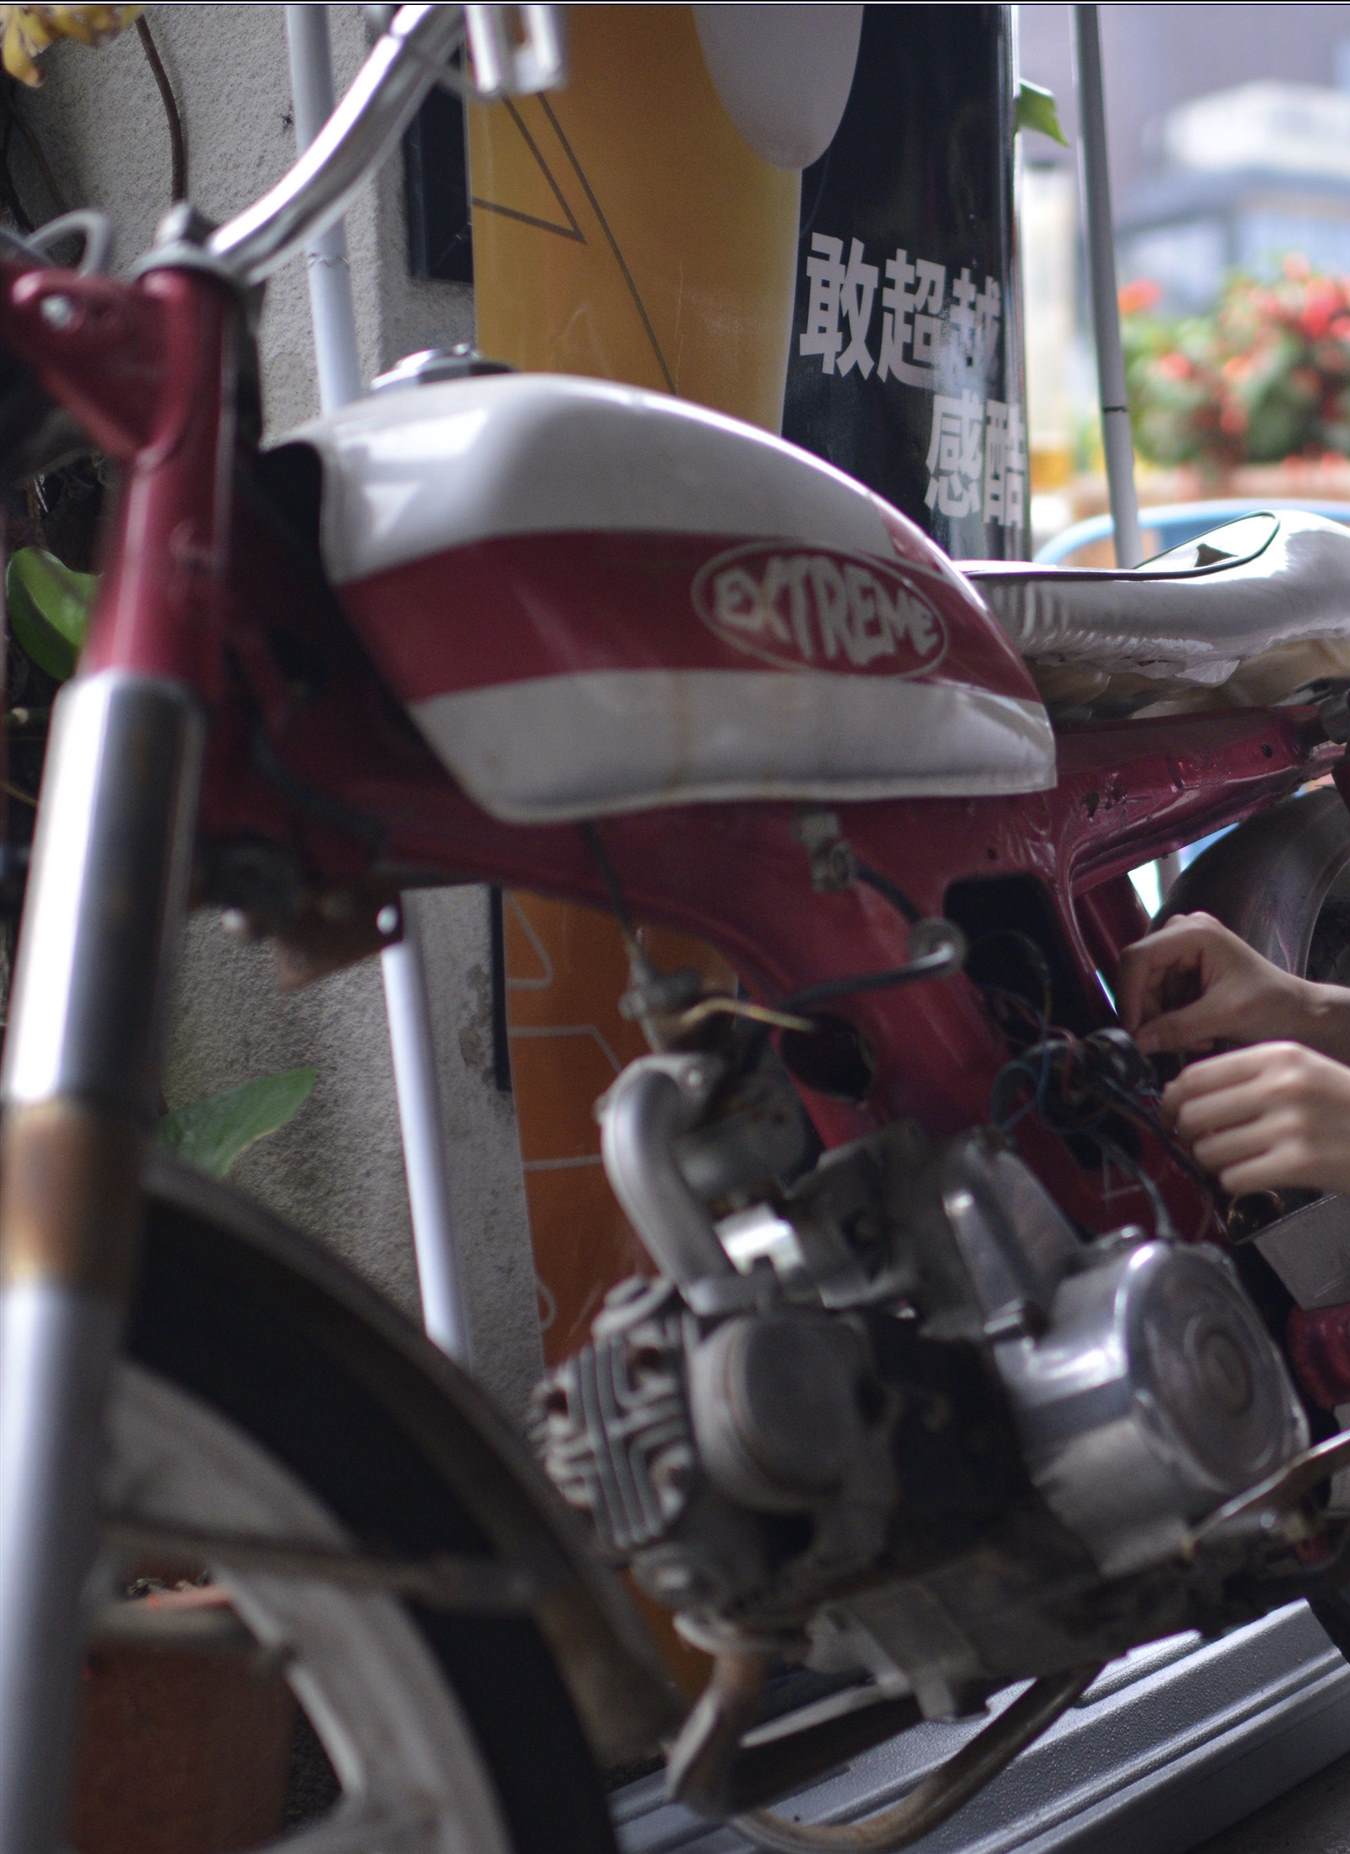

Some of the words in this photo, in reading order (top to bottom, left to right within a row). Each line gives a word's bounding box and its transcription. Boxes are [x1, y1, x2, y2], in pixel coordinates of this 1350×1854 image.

[800, 232, 1001, 391] 敢超越
[714, 555, 938, 666] EXTREME
